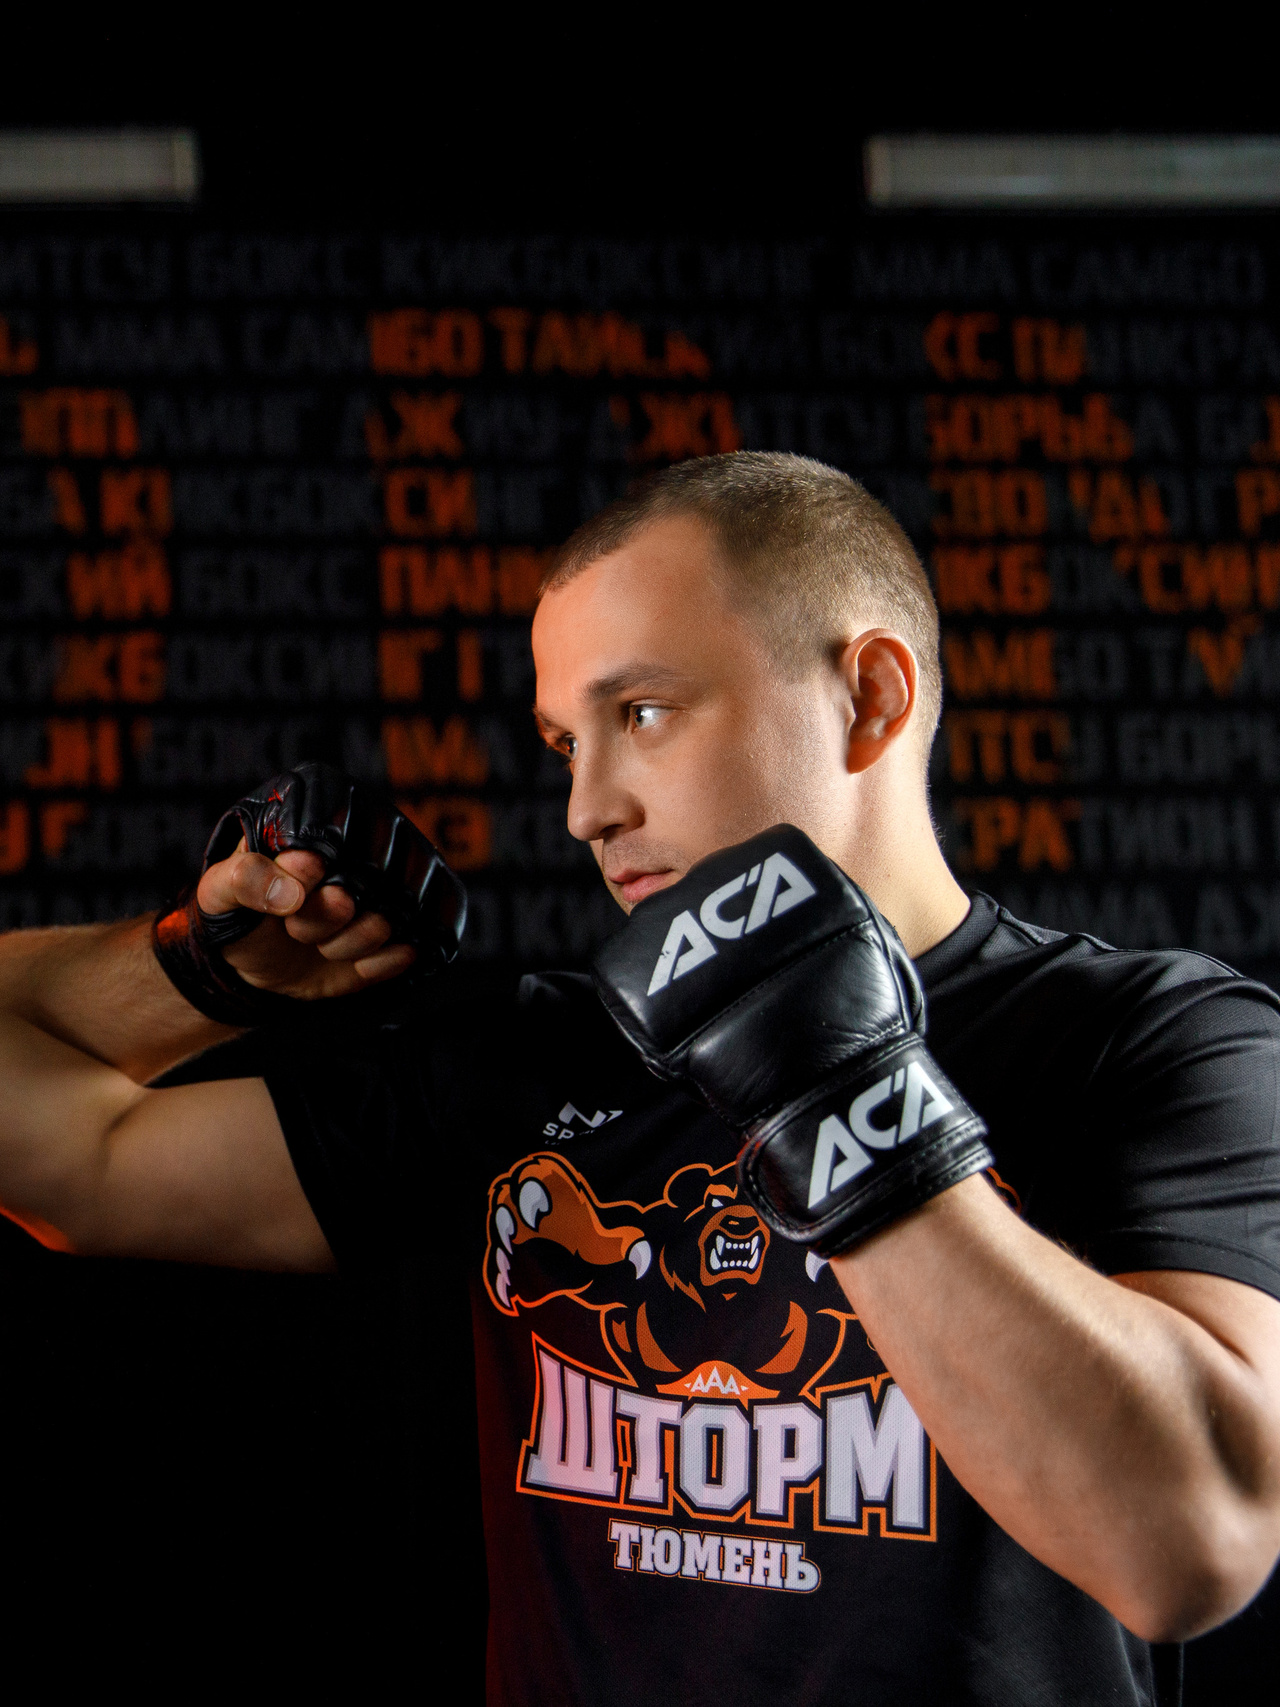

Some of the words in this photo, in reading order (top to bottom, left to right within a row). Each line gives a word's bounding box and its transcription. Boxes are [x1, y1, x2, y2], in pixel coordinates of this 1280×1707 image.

[187, 234, 365, 298] БОКС
[380, 234, 826, 300] КИКБОКСИНГ
[852, 236, 1020, 300] ММА
[1028, 236, 1268, 304] САМБО
[53, 308, 224, 378] ММА
[242, 304, 488, 380] САМБО
[820, 308, 1004, 384] БОКС
[906, 391, 1186, 464] БОРЬБА
[97, 464, 565, 541] КИКБОКСИНГ
[180, 546, 366, 620] БОКС
[340, 712, 524, 790] ММА
[647, 852, 816, 997] ACA
[807, 1060, 955, 1210] ACA
[524, 1347, 928, 1530] ШТОРМ
[608, 1517, 822, 1594] ТЮМЕНЬ
